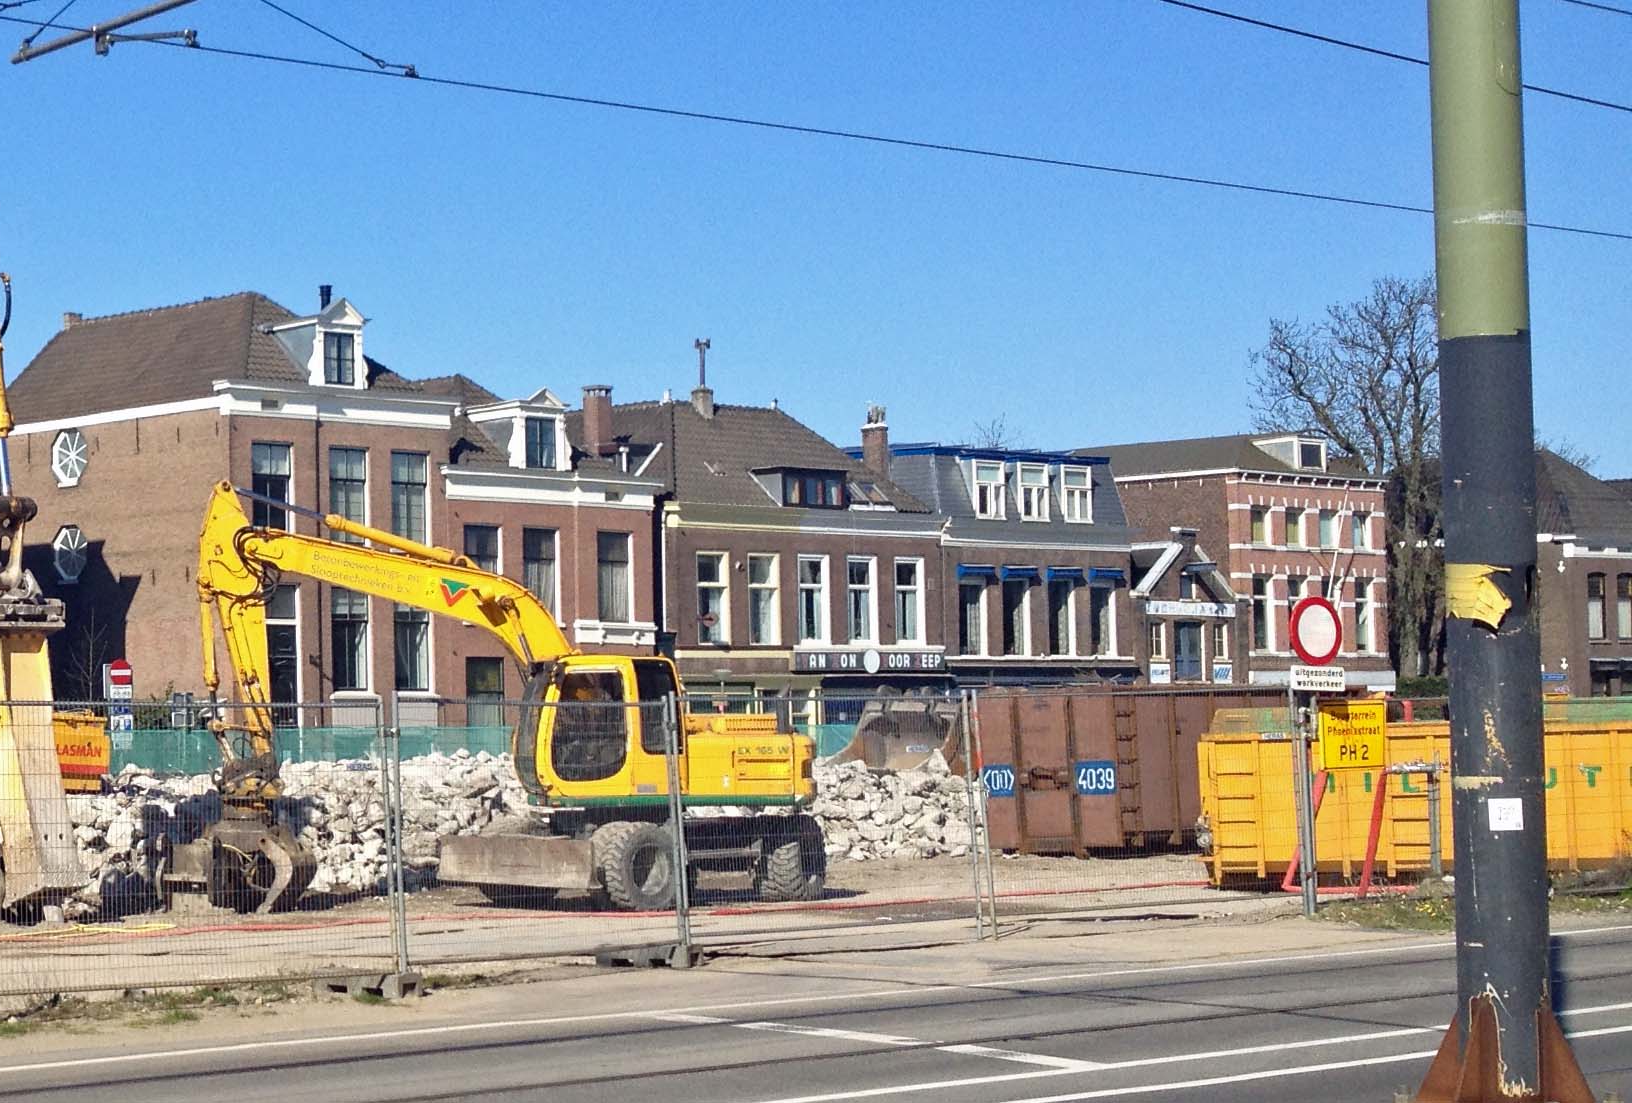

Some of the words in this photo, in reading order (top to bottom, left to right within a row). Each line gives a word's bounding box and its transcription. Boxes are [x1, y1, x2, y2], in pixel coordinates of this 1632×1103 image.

[1330, 710, 1377, 722] Boterrein
[55, 743, 102, 758] LASMAN
[1340, 744, 1357, 761] PH
[1361, 744, 1369, 760] 2
[1078, 768, 1115, 790] 4039
